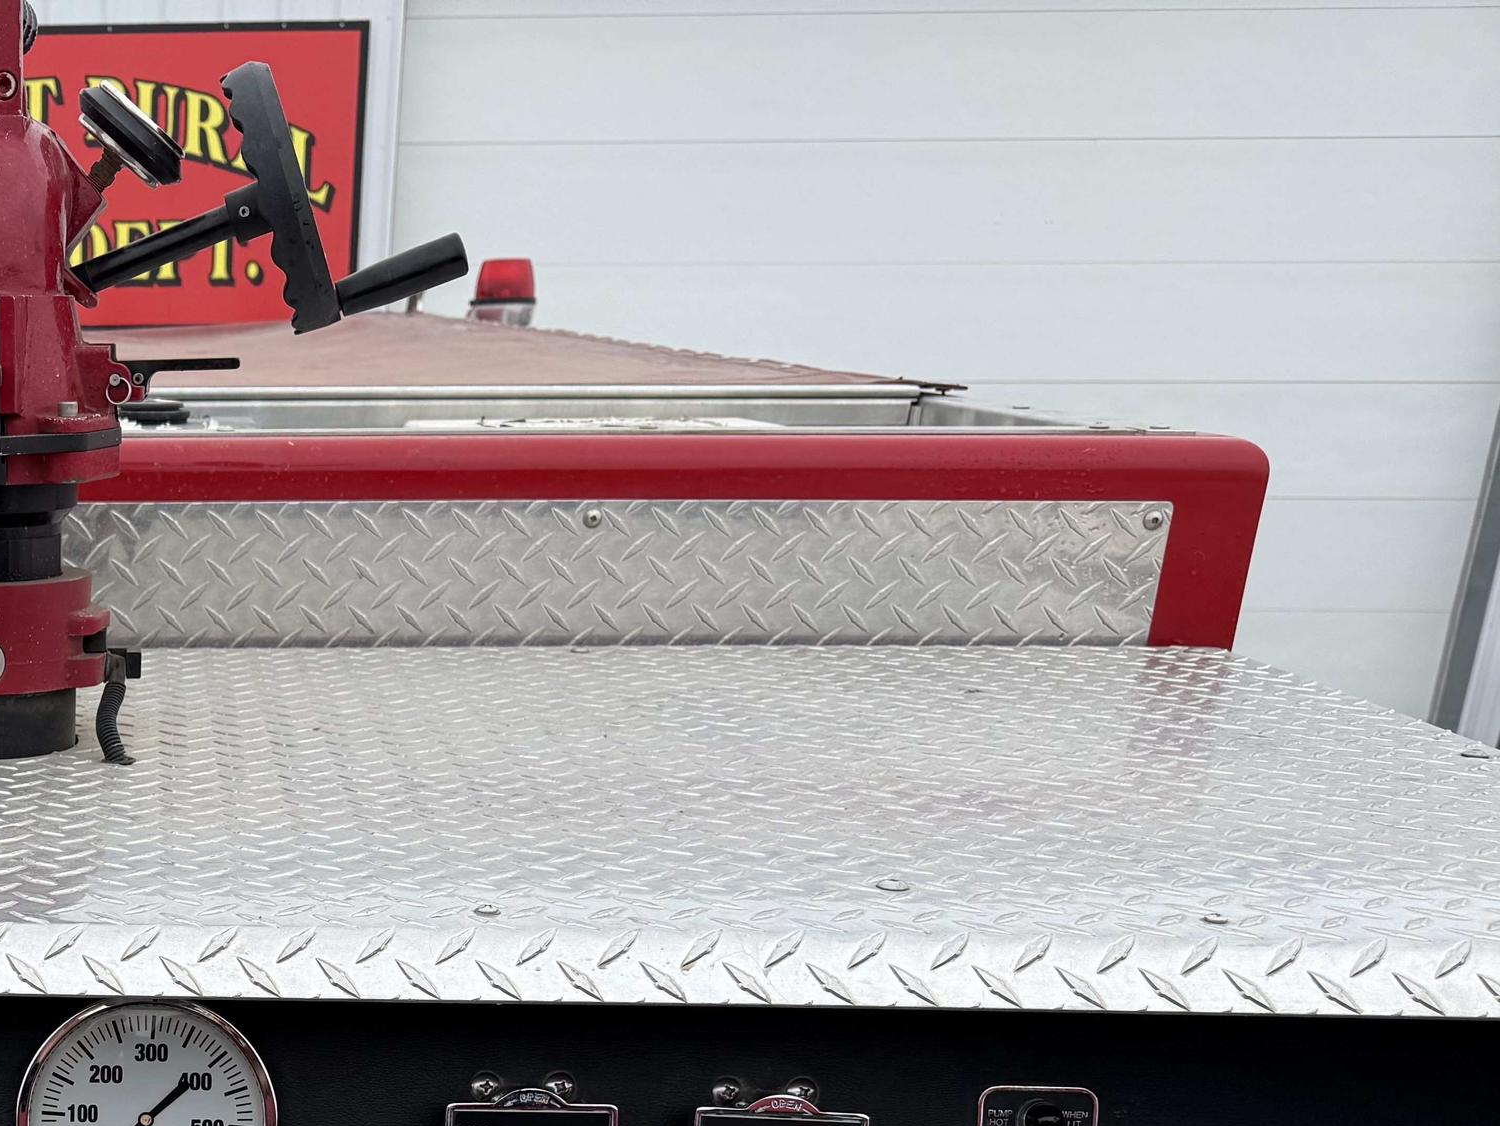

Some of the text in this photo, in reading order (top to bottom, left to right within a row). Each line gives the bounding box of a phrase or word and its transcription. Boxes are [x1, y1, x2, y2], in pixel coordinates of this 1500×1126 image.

[69, 221, 264, 286] DET.
[134, 1043, 169, 1062] 300
[89, 1065, 123, 1084] 200
[519, 1093, 550, 1104] OPEN
[771, 1100, 803, 1112] OPEN
[67, 1104, 98, 1123] 100
[988, 1109, 1013, 1117] PUMP
